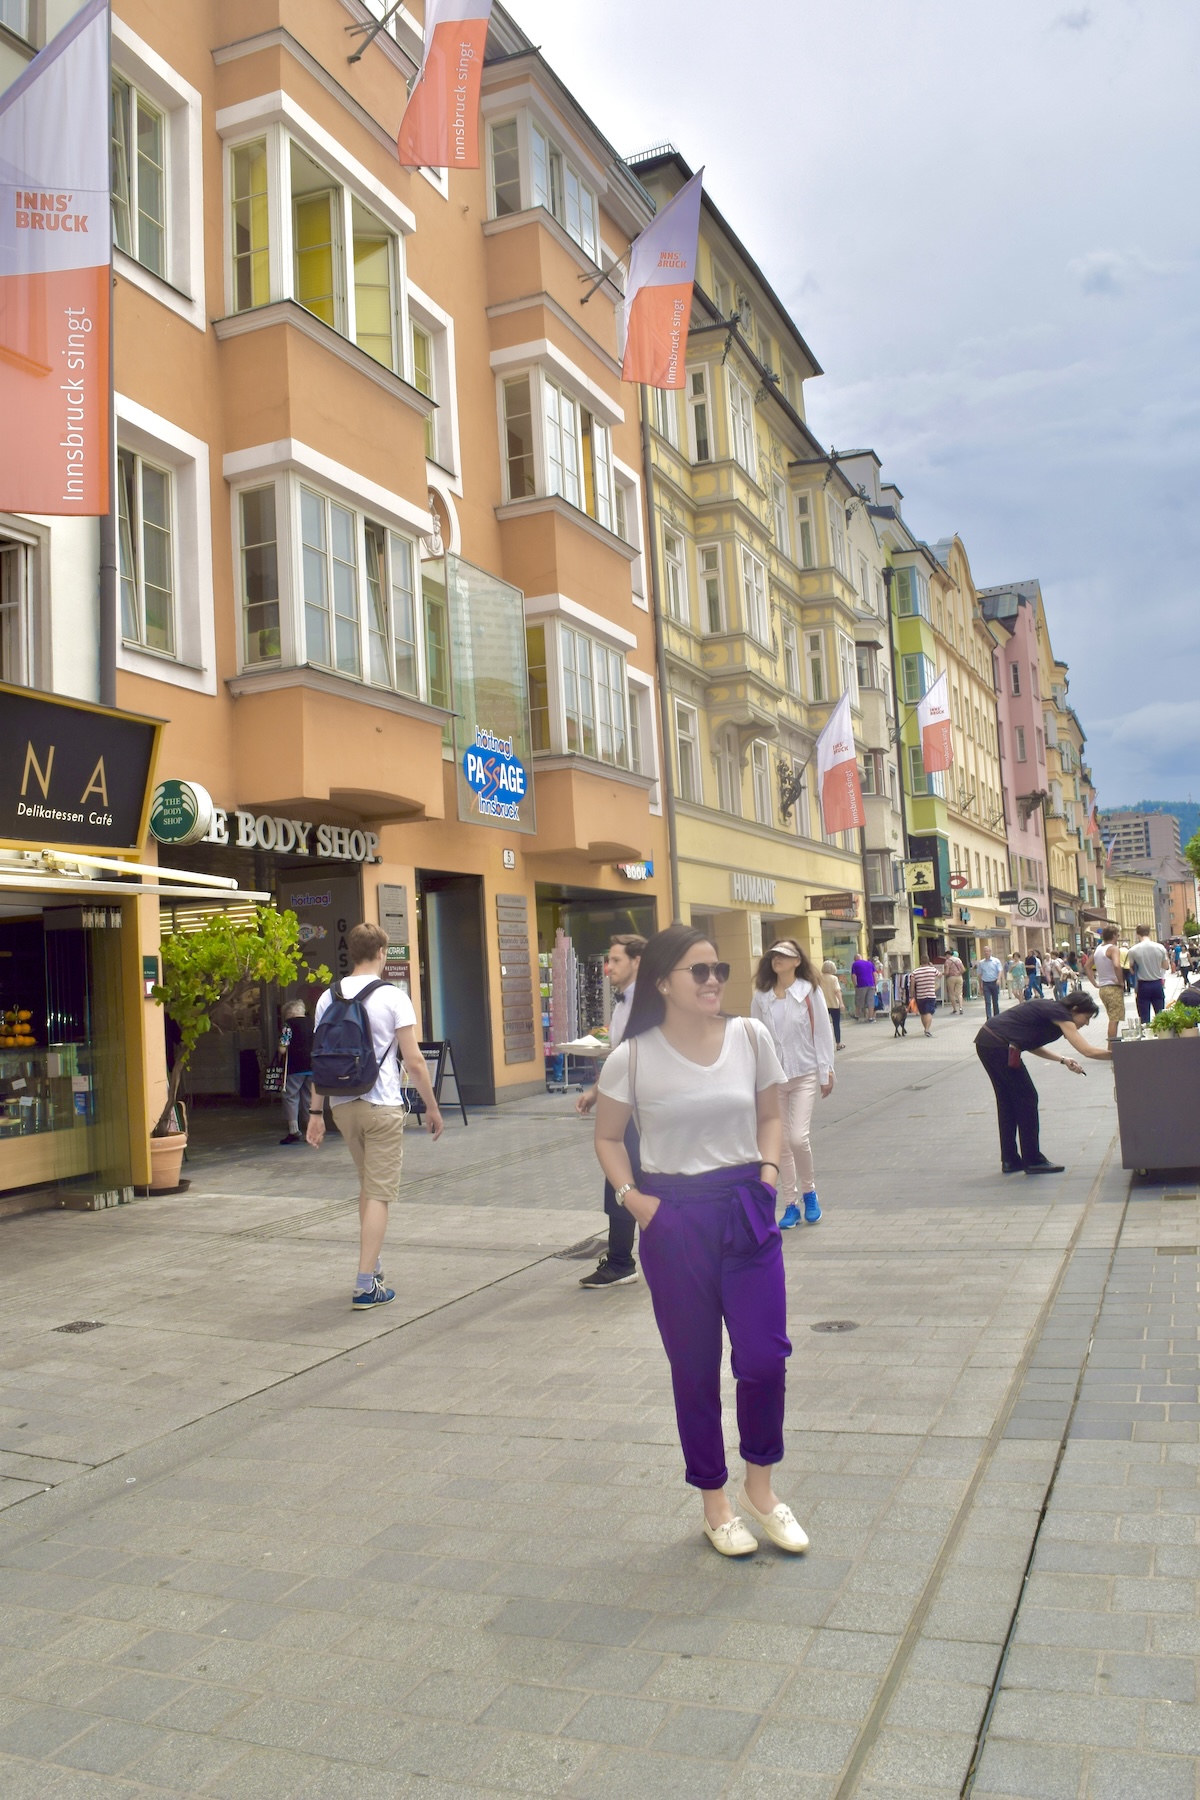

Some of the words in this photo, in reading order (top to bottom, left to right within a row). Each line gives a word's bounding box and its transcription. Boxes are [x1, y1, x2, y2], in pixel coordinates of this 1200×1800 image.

[456, 41, 475, 80] singt
[452, 85, 467, 160] Innsbruck
[16, 191, 73, 212] INNS'
[16, 211, 89, 232] BRUCK
[657, 260, 687, 268] BRUCK
[671, 299, 684, 327] singt
[61, 306, 92, 370] singt
[666, 329, 680, 384] Innsbruck
[60, 377, 84, 501] Innsbruck
[475, 725, 513, 760] hörtnagl
[467, 753, 524, 794] PASSAGE
[845, 769, 854, 787] singt
[17, 802, 84, 822] Delikatessen
[88, 811, 113, 826] Café
[163, 807, 183, 816] BODY
[164, 798, 181, 806] THE
[477, 791, 520, 821] Innsbruck
[847, 788, 859, 824] Innsbruck
[163, 817, 183, 825] SHOP
[235, 811, 312, 854] BODY
[317, 824, 379, 863] SHOP
[626, 864, 647, 880] BOOK
[291, 891, 331, 907] hörtnagl
[732, 873, 777, 905] HUMANIC
